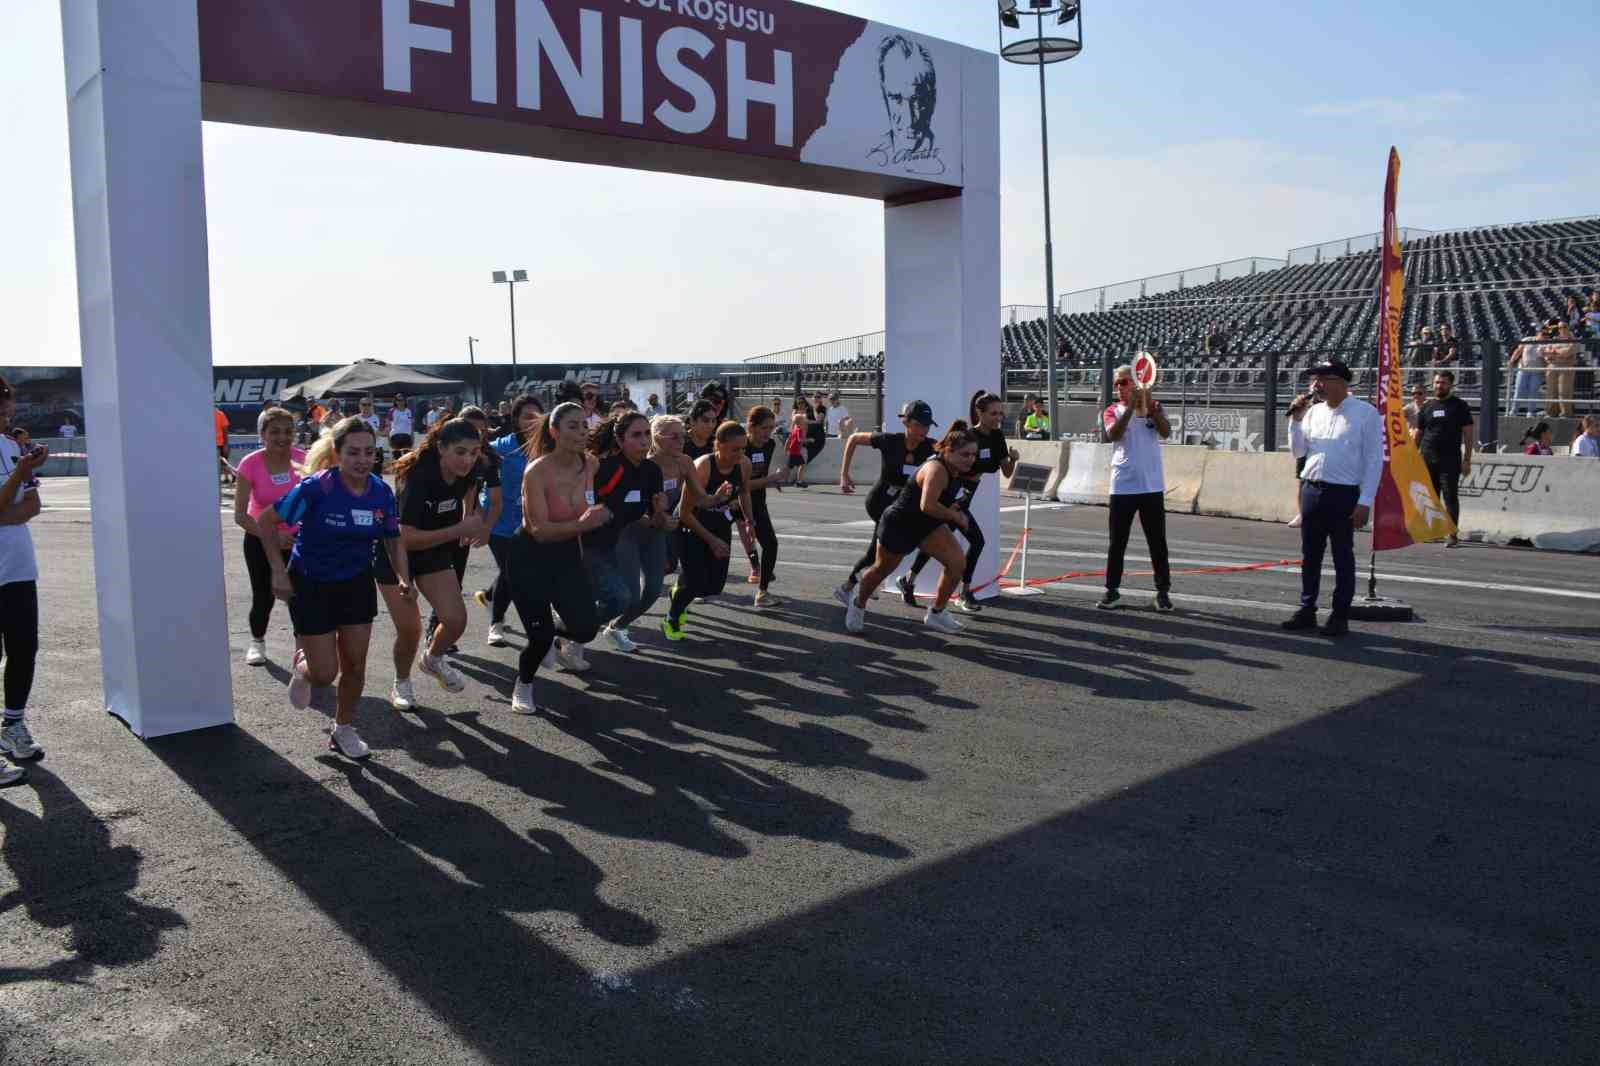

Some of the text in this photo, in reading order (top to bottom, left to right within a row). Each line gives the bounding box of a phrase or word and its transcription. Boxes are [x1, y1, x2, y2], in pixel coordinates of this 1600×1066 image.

[677, 0, 775, 34] KOŞUSU
[382, 0, 794, 148] FINISH
[215, 378, 289, 401] NEU
[1184, 411, 1241, 431] event
[1458, 462, 1545, 493] NEU
